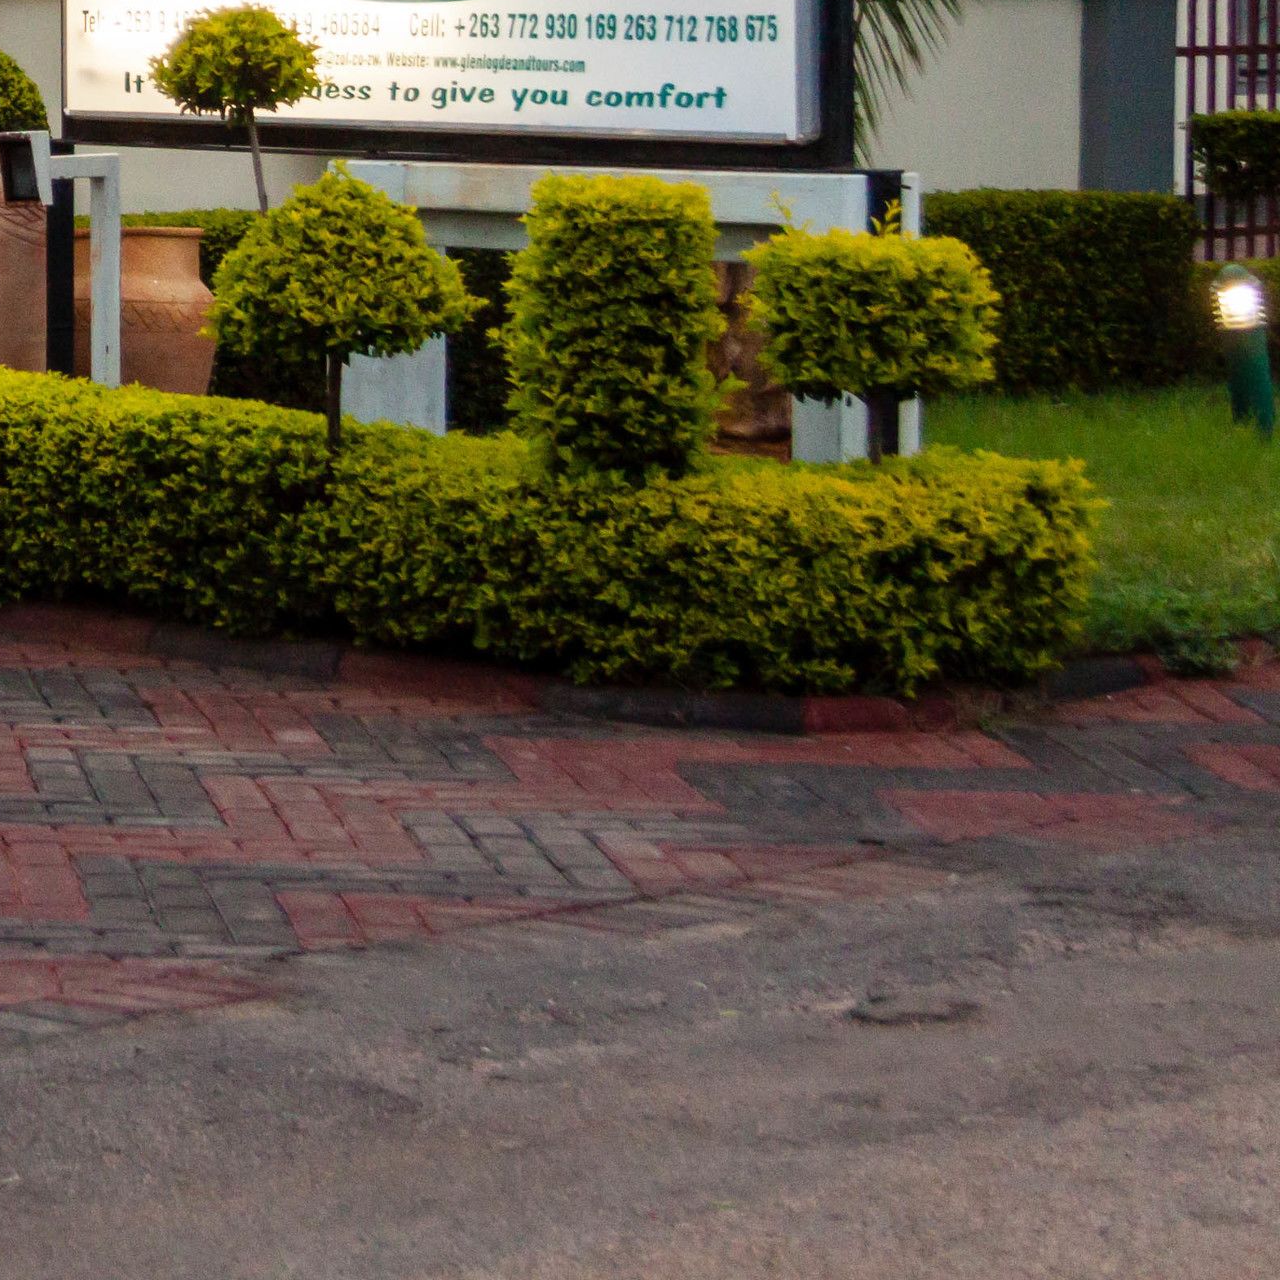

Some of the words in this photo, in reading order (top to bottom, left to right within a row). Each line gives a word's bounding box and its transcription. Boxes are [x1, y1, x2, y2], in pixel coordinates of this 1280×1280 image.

[320, 12, 381, 37] 460584
[409, 13, 446, 38] Cell:
[455, 12, 500, 39] +263
[507, 12, 539, 39] 772
[545, 13, 578, 39] 930
[585, 13, 617, 40] 169
[624, 14, 657, 41] 263
[664, 14, 698, 42] 712
[705, 15, 739, 43] 768
[745, 15, 778, 42] 675
[386, 51, 429, 68] Website:
[389, 81, 420, 102] to
[431, 81, 495, 109] give
[511, 87, 569, 112] you
[585, 82, 728, 109] comfort
